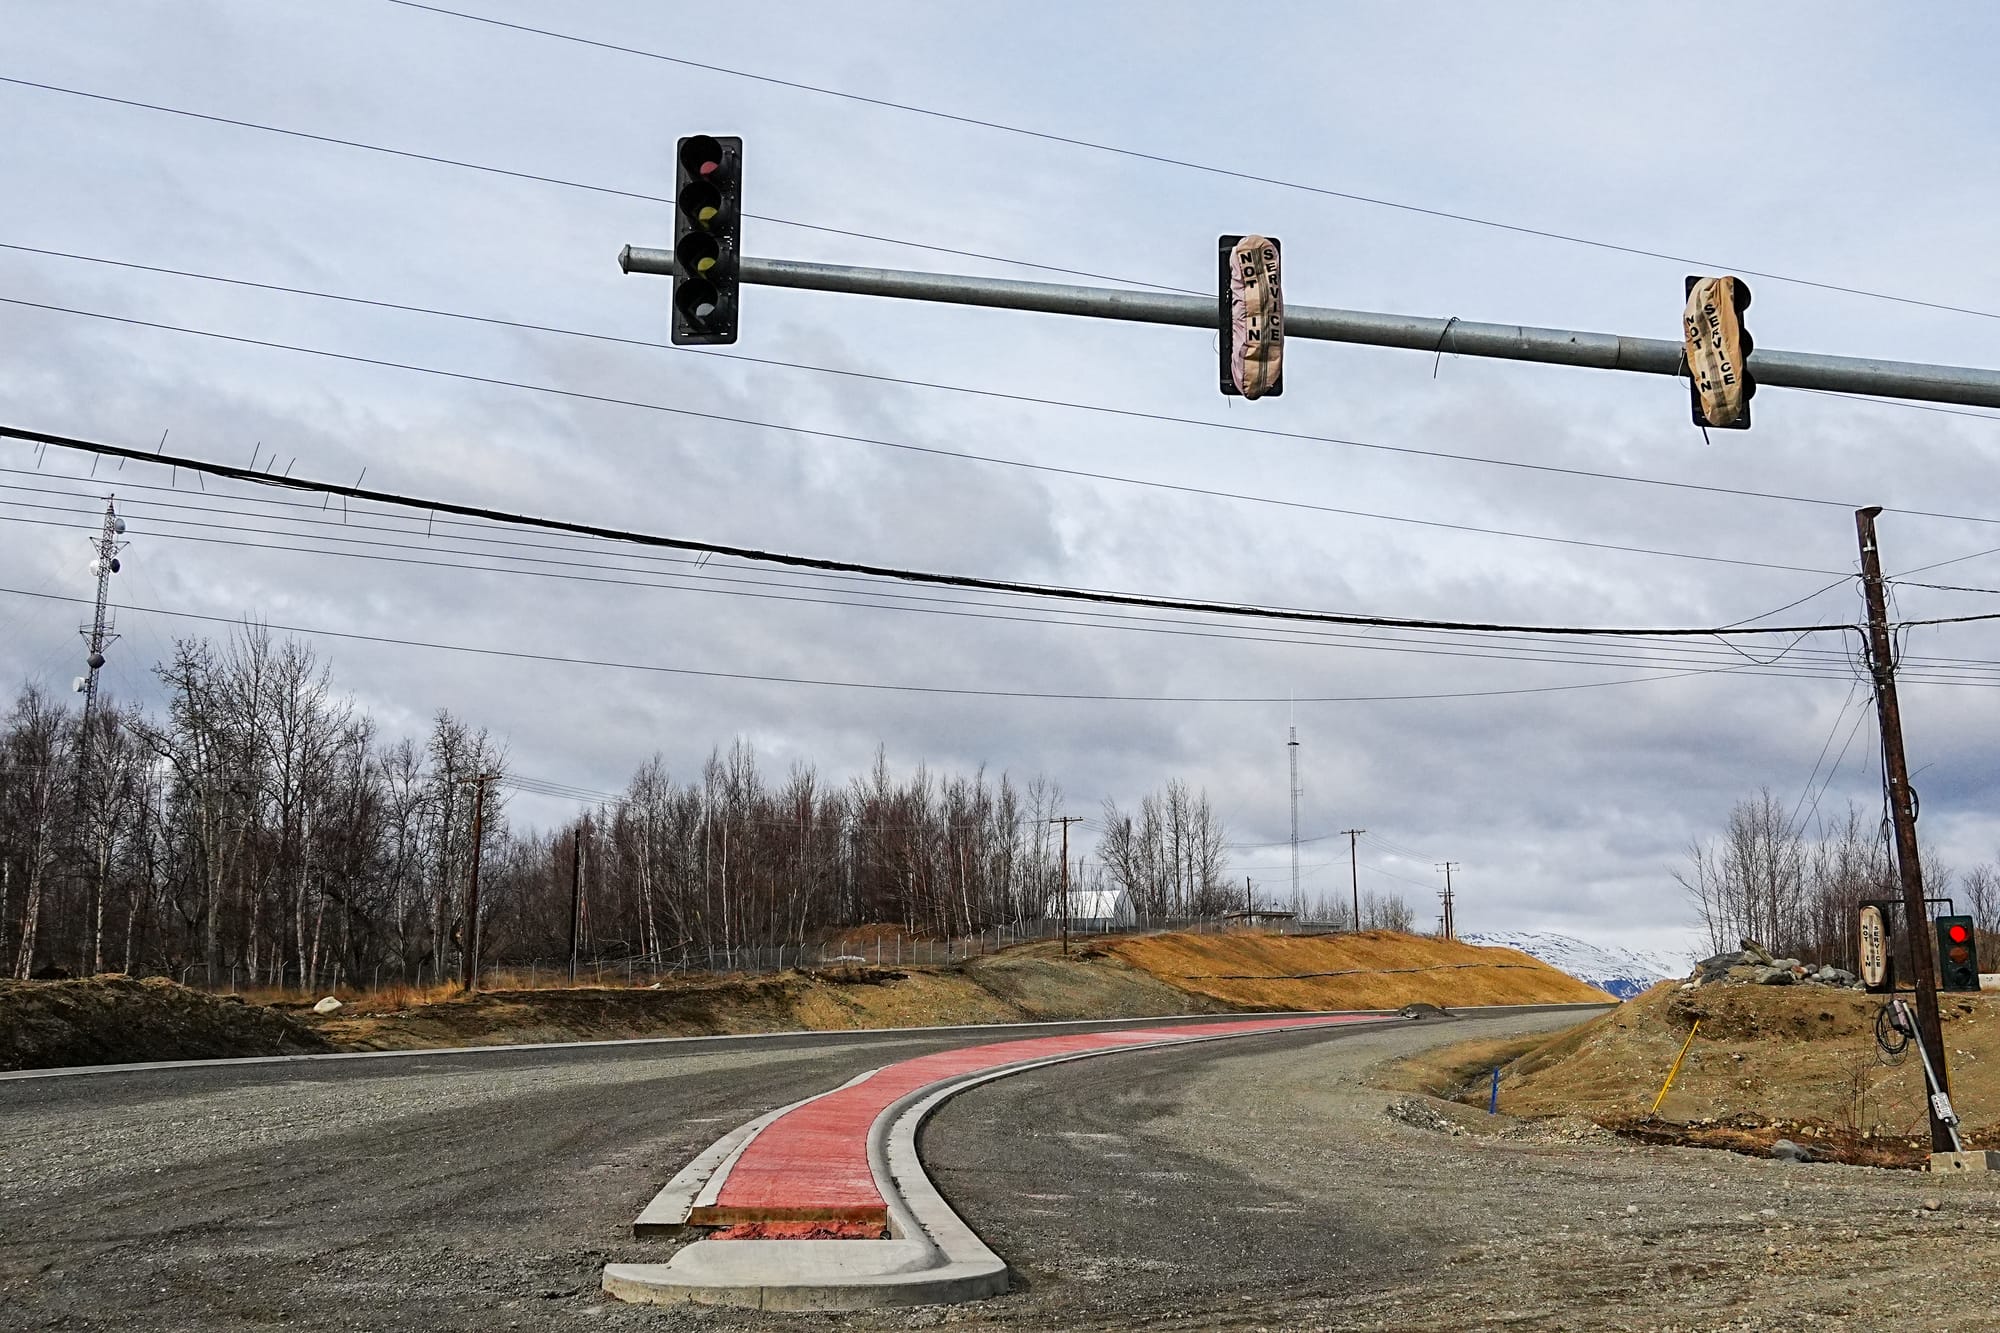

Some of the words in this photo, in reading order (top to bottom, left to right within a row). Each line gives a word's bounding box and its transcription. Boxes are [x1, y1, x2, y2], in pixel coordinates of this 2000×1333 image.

[1240, 252, 1256, 288] NOT
[1248, 317, 1261, 341] IN
[1263, 249, 1280, 341] SERVICE
[1686, 315, 1702, 349] NOT
[1700, 371, 1712, 392] IN
[1865, 955, 1871, 967] IN
